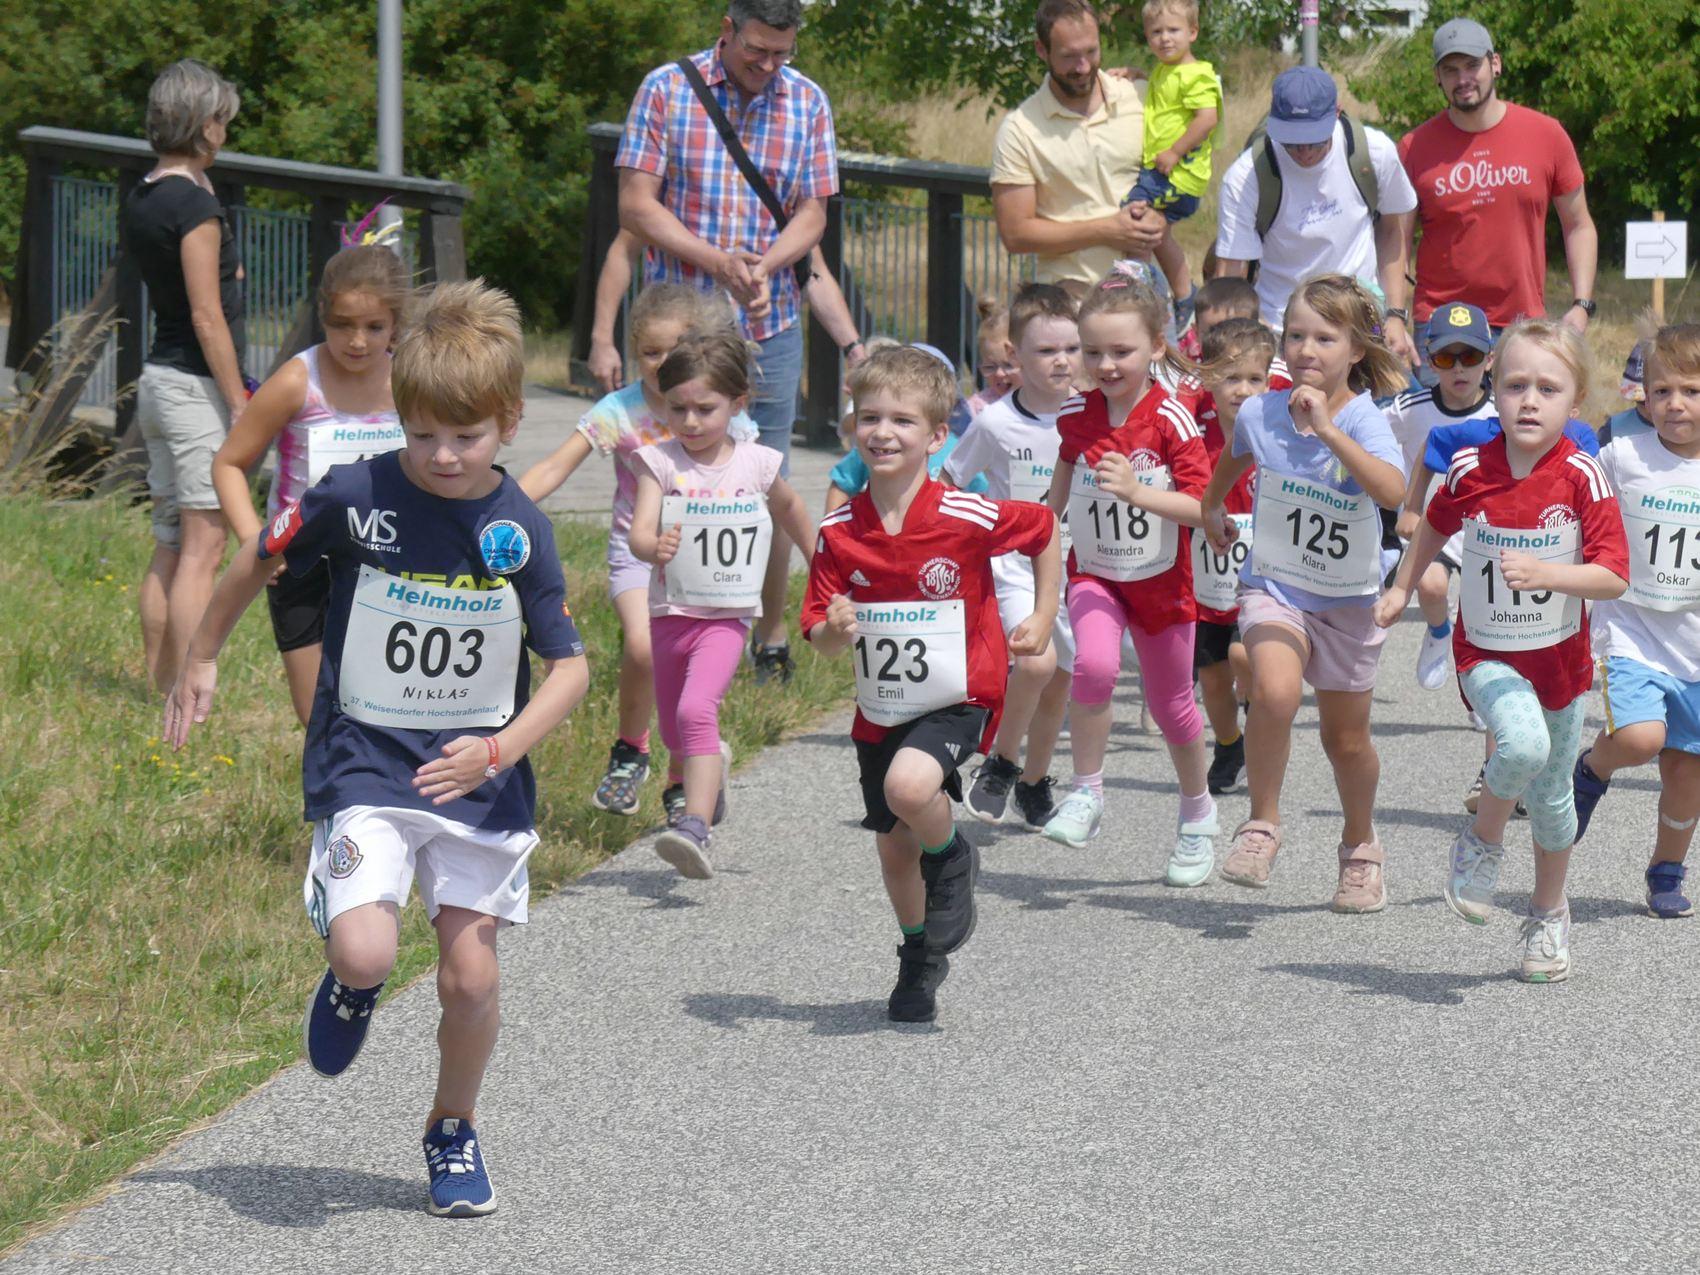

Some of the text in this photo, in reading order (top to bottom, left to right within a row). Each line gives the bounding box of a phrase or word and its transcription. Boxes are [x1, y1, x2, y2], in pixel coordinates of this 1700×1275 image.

[1435, 160, 1531, 196] s.Oliver
[1281, 480, 1359, 512] Helmholz
[347, 506, 397, 543] MS
[1088, 500, 1149, 541] 118
[1286, 508, 1350, 560] 125
[1476, 528, 1561, 549] Helmholz
[693, 526, 758, 567] 107
[1097, 543, 1144, 557] Alexandra
[1302, 553, 1326, 572] Klara
[713, 571, 742, 583] Clara
[1213, 579, 1233, 590] Jona
[1656, 572, 1691, 586] Oskar
[386, 582, 503, 612] Helmholz
[856, 608, 937, 622] elmholz
[1490, 609, 1542, 623] Johanna
[385, 620, 485, 678] 603
[855, 635, 929, 683] 123
[402, 686, 470, 700] NIKLAS
[877, 686, 904, 700] Emil
[349, 696, 500, 717] 37. Weisendorfer Hochstraßenlauf
